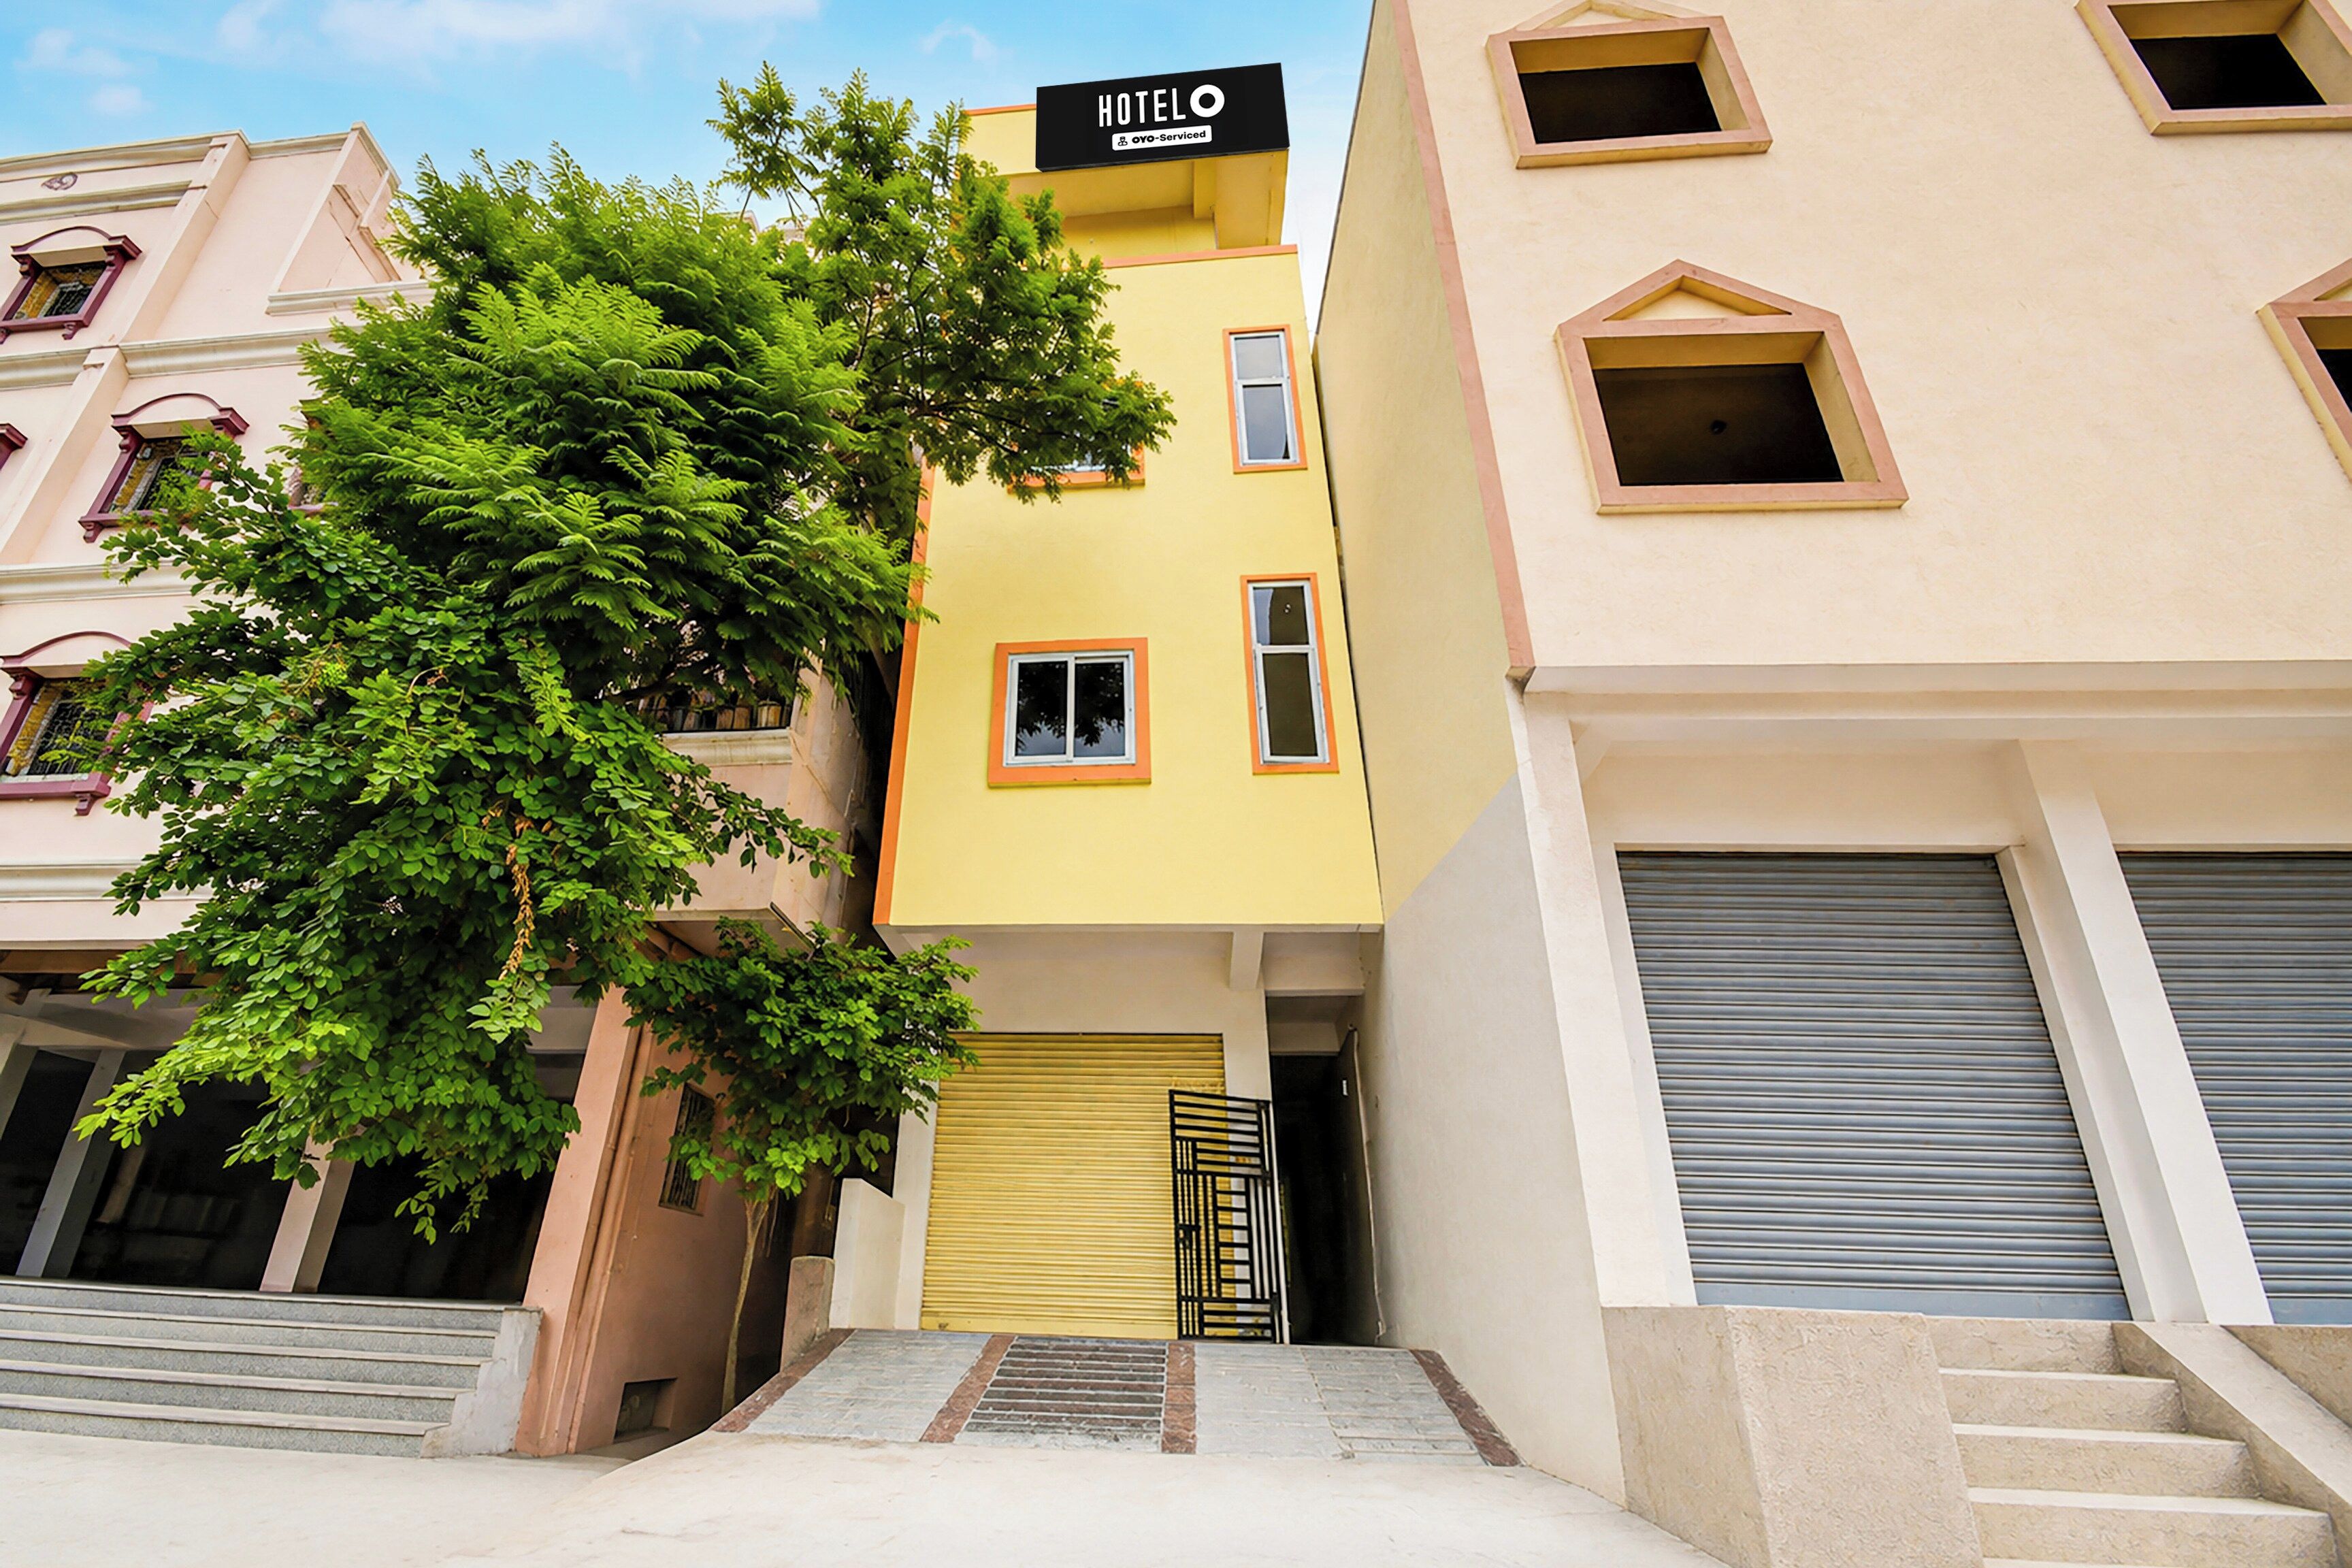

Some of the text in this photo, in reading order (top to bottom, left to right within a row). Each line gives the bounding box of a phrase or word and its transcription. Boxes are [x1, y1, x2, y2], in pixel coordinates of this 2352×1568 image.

[1098, 84, 1225, 127] HOTEL O
[1132, 130, 1207, 144] OYO-Serviced
